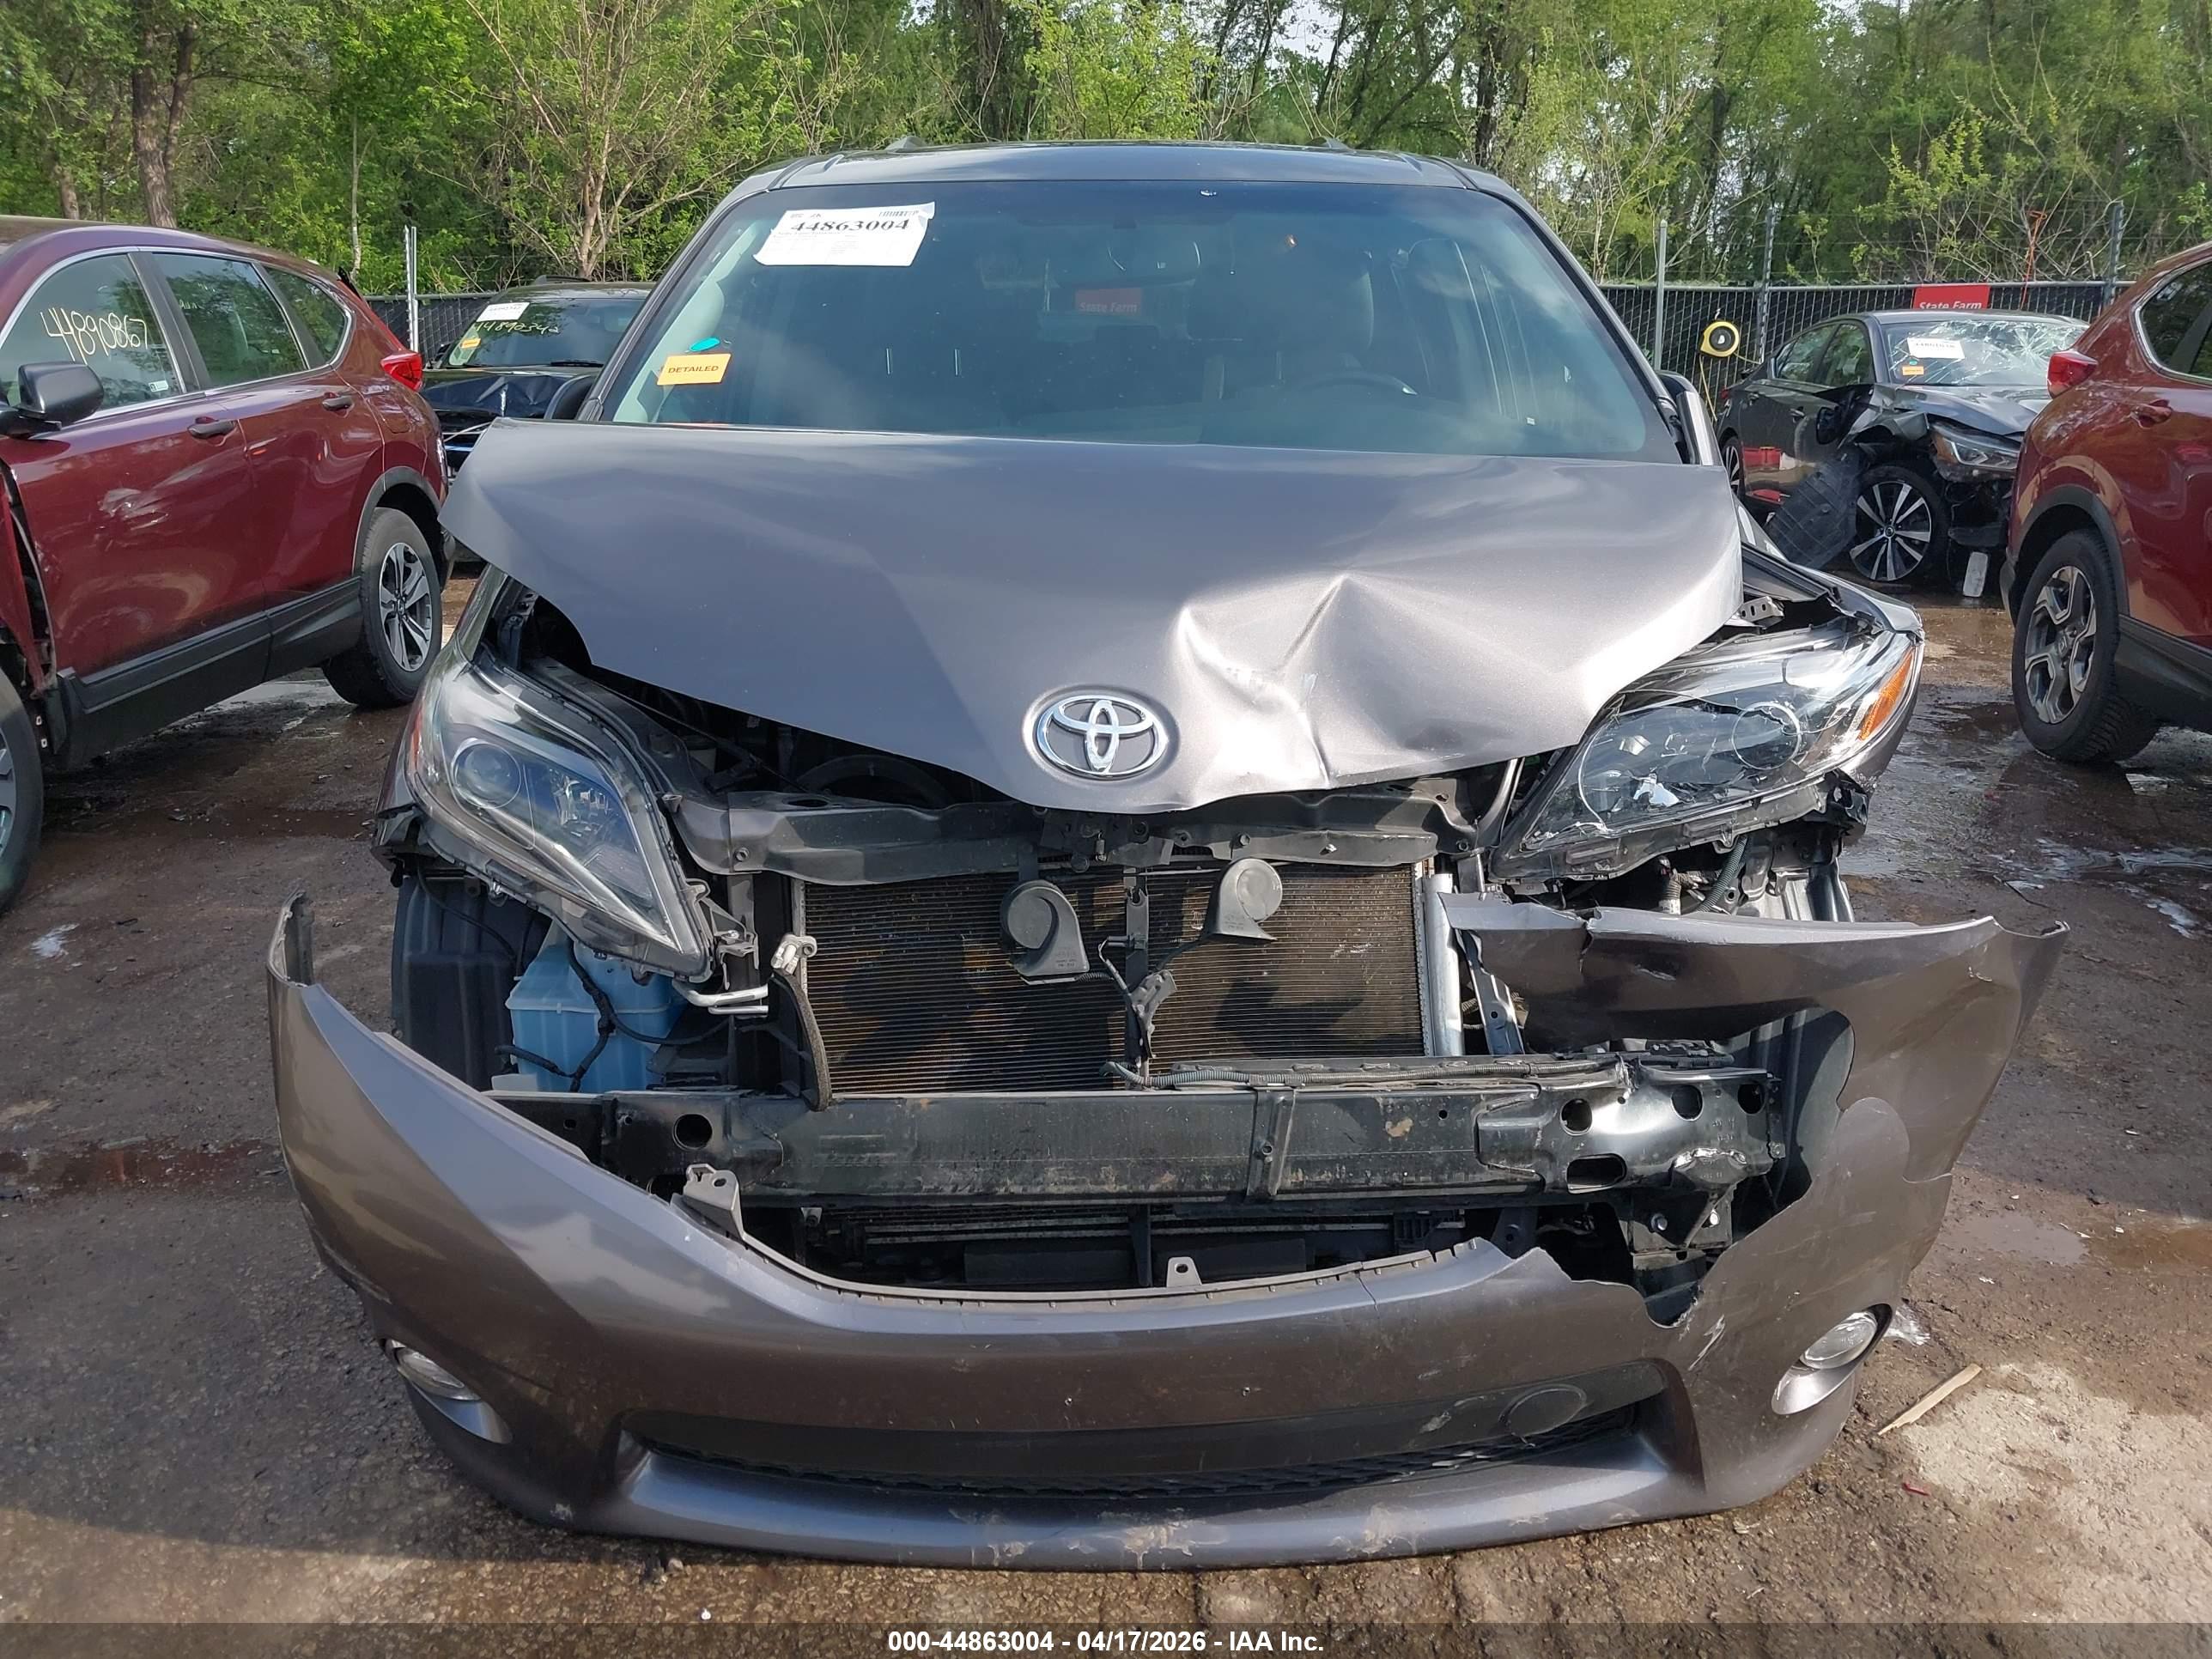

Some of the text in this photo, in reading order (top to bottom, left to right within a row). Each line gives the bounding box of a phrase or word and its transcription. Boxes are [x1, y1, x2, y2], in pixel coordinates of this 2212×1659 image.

[790, 219, 910, 232] 44863004
[1079, 301, 1138, 313] State Farm
[1952, 301, 1982, 309] Farm
[40, 307, 148, 365] 44890867
[668, 365, 720, 374] DETAILED
